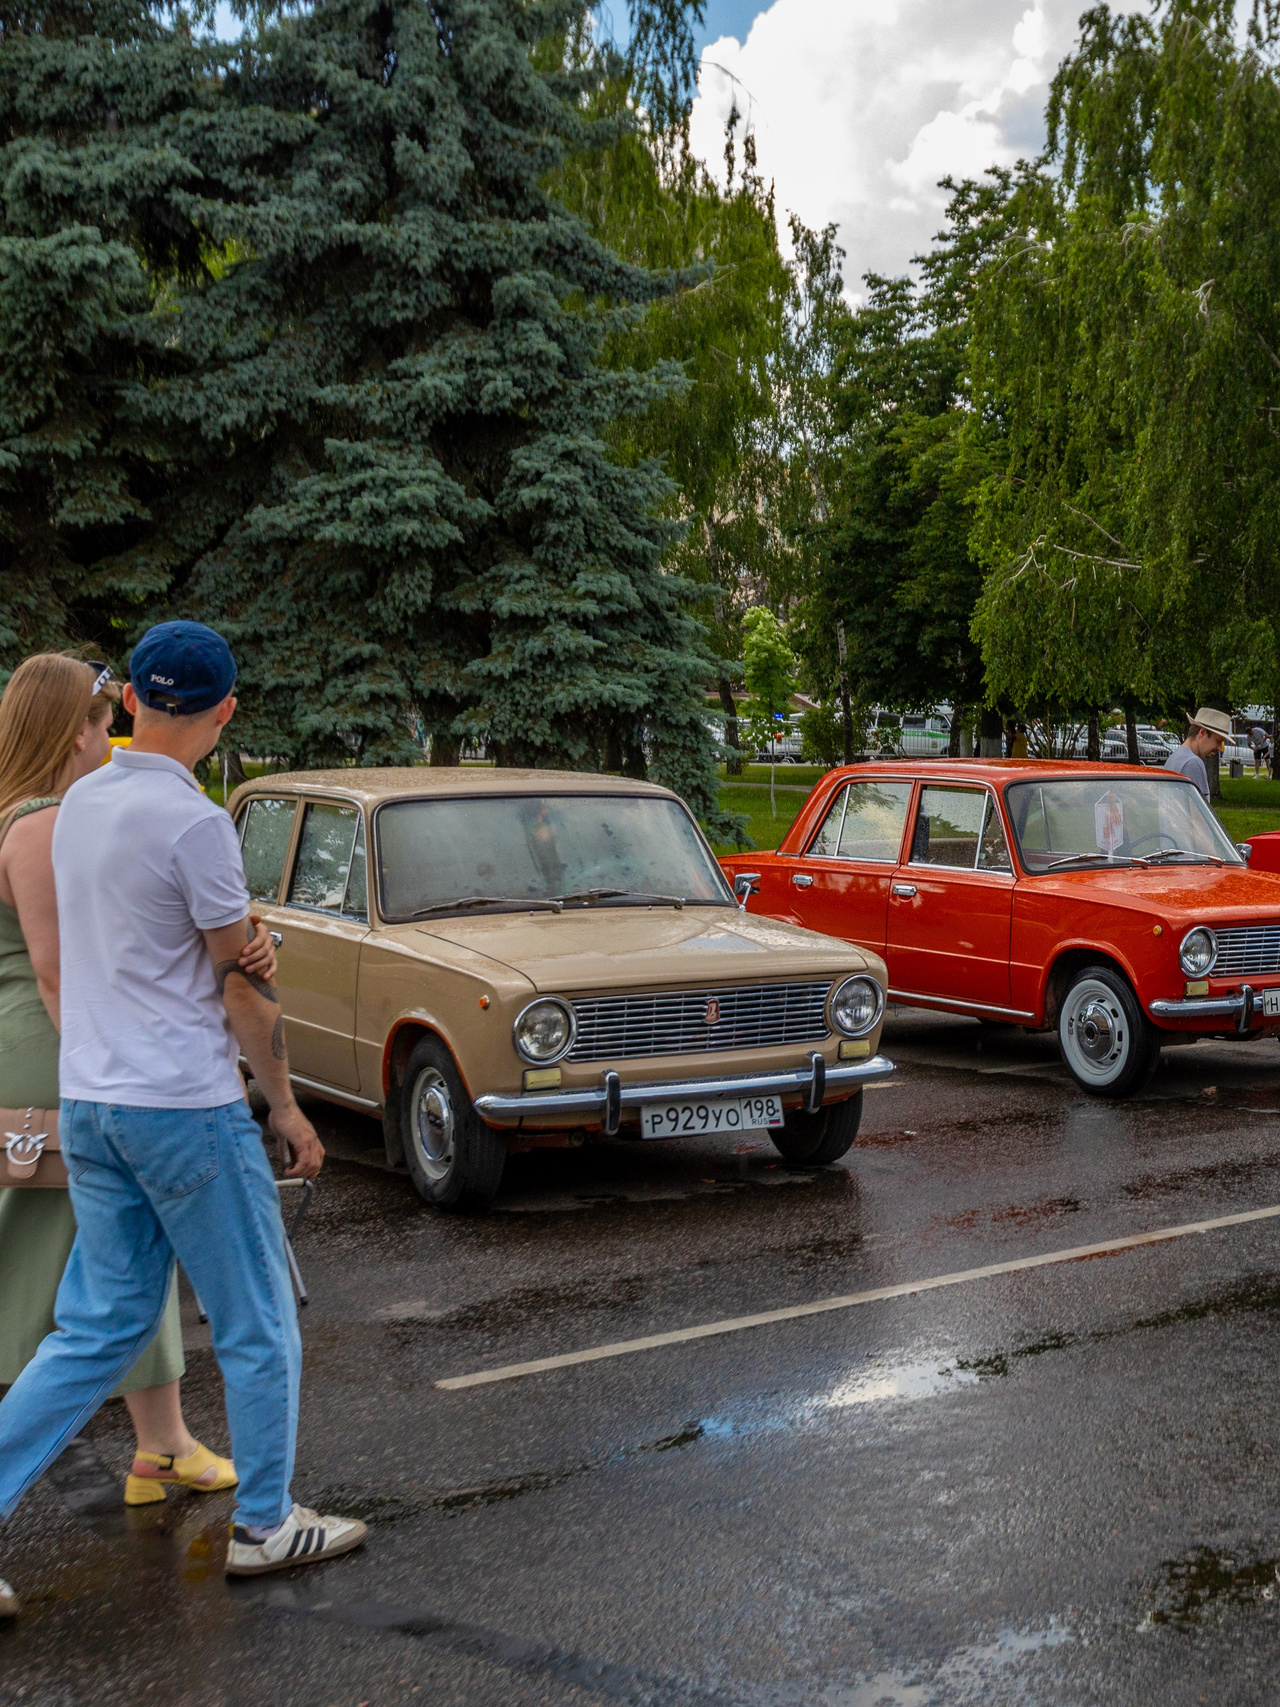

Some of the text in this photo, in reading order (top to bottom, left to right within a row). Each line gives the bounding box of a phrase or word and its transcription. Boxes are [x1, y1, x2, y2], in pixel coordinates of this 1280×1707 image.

[150, 673, 174, 686] POLO
[743, 1098, 775, 1119] 198
[752, 1117, 768, 1126] RUS
